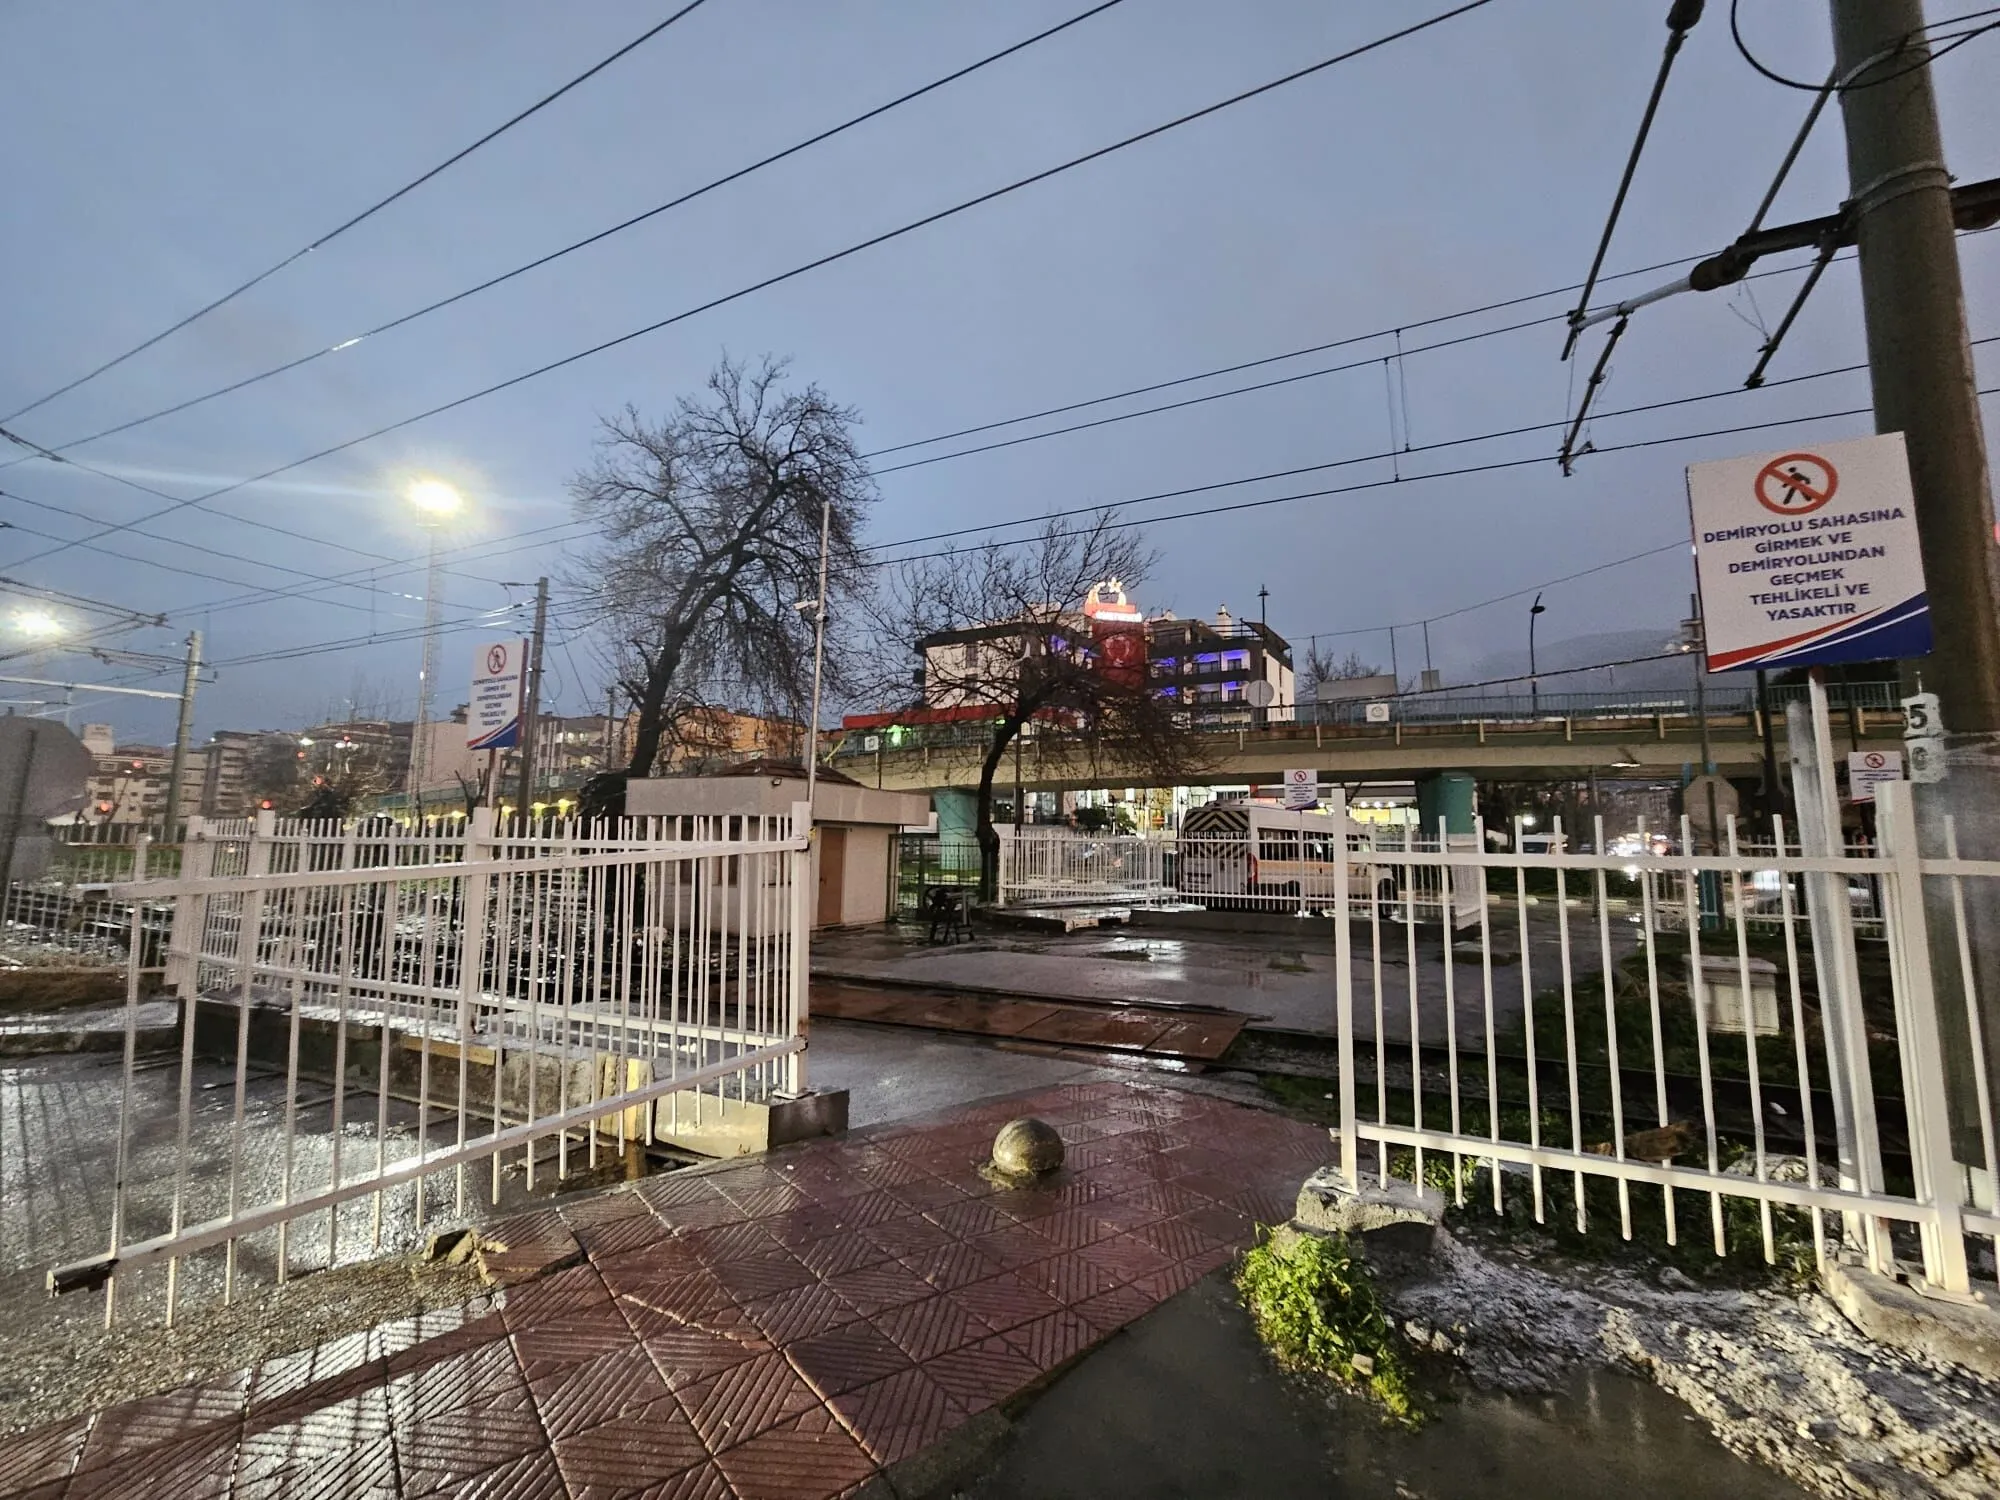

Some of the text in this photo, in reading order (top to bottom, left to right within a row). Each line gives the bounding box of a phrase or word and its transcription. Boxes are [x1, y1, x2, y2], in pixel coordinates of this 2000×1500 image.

[1704, 507, 1905, 543] DEMİRYOLU SAHASINA
[1755, 531, 1853, 554] GİRMEK VE
[1729, 545, 1885, 574] DEMİRYOLUNDAN
[1770, 567, 1845, 587] GEÇMEK
[1750, 582, 1870, 605] TEHLİKELİ VE
[1766, 602, 1856, 622] YASAKTIR
